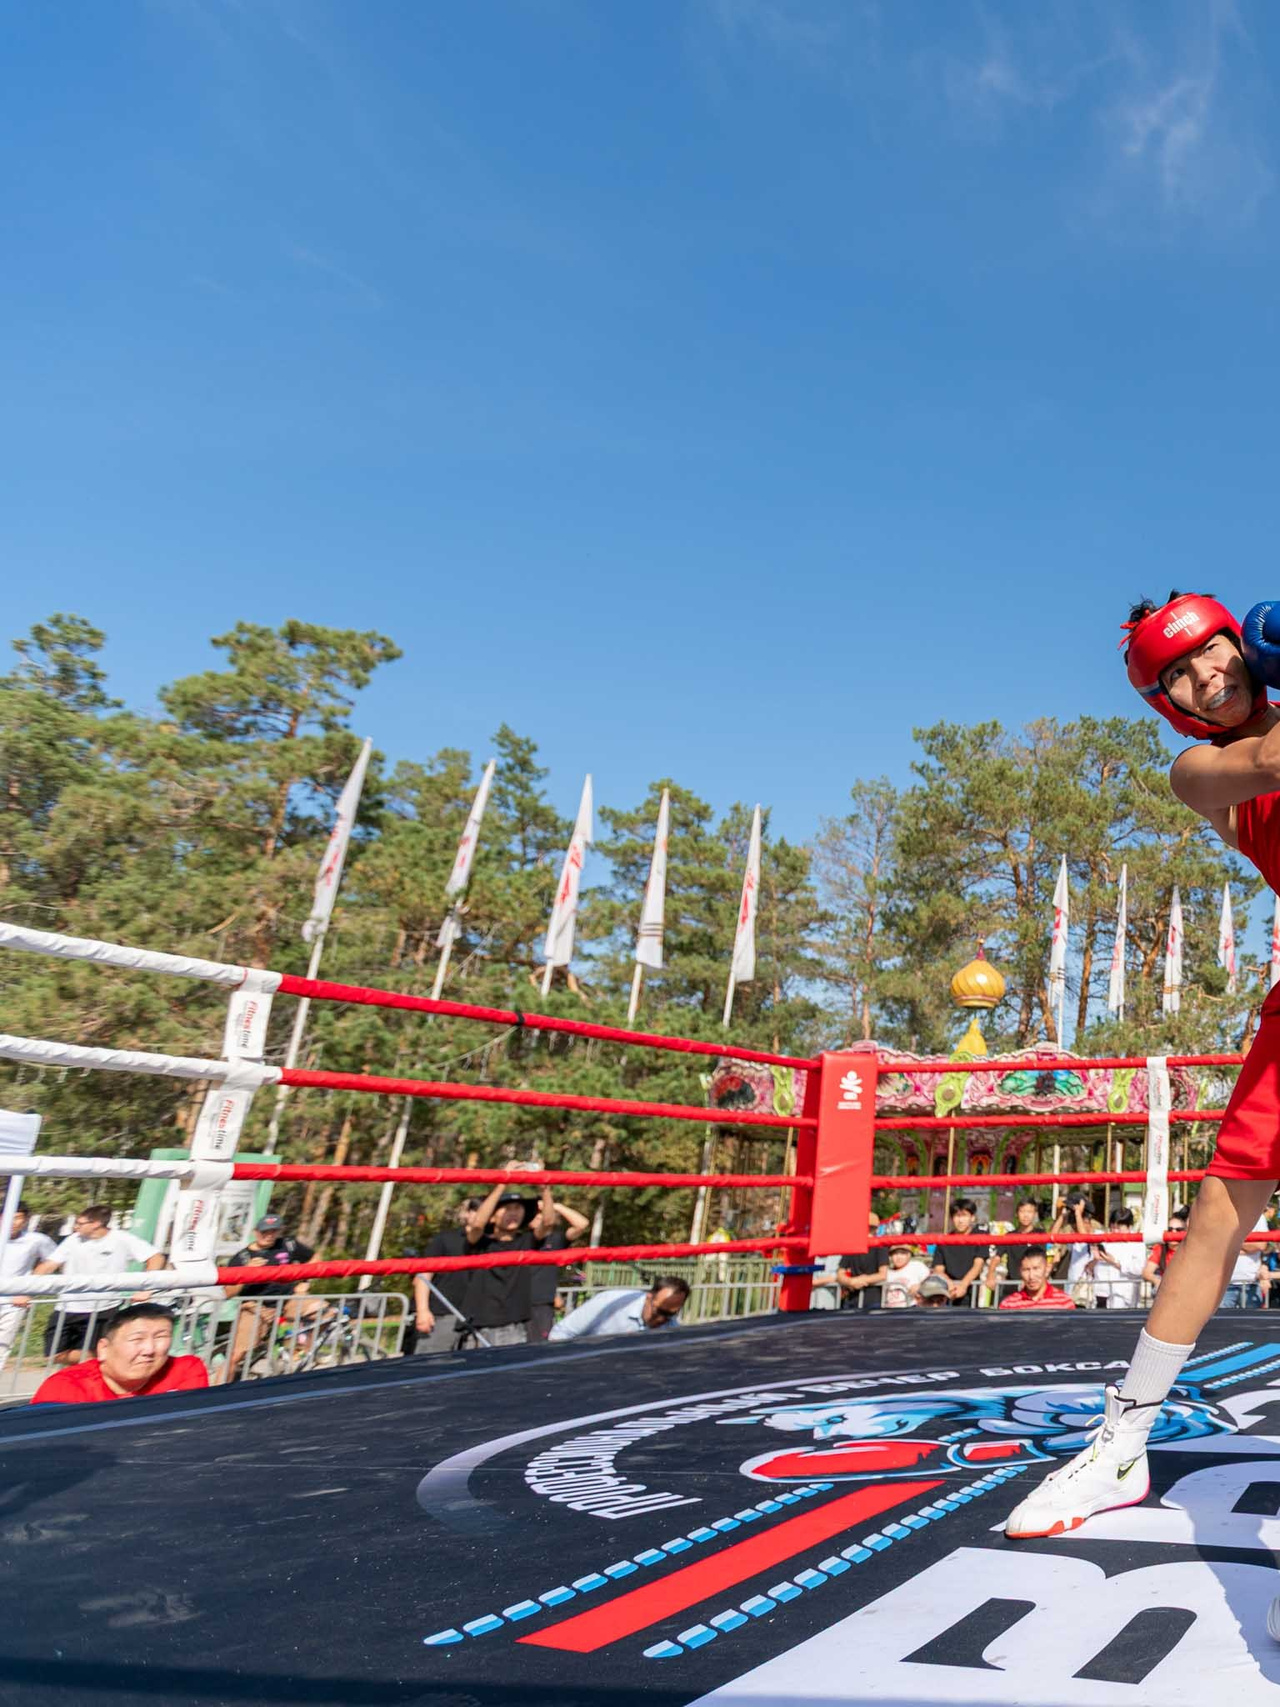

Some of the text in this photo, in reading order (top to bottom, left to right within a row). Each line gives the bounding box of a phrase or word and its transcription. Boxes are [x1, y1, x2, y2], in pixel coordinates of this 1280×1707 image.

[1163, 611, 1200, 639] clinch
[524, 1359, 1131, 1519] ПРОФЕССИОНАЛЬНЫЙ ВЕЧЕР БОКСА
